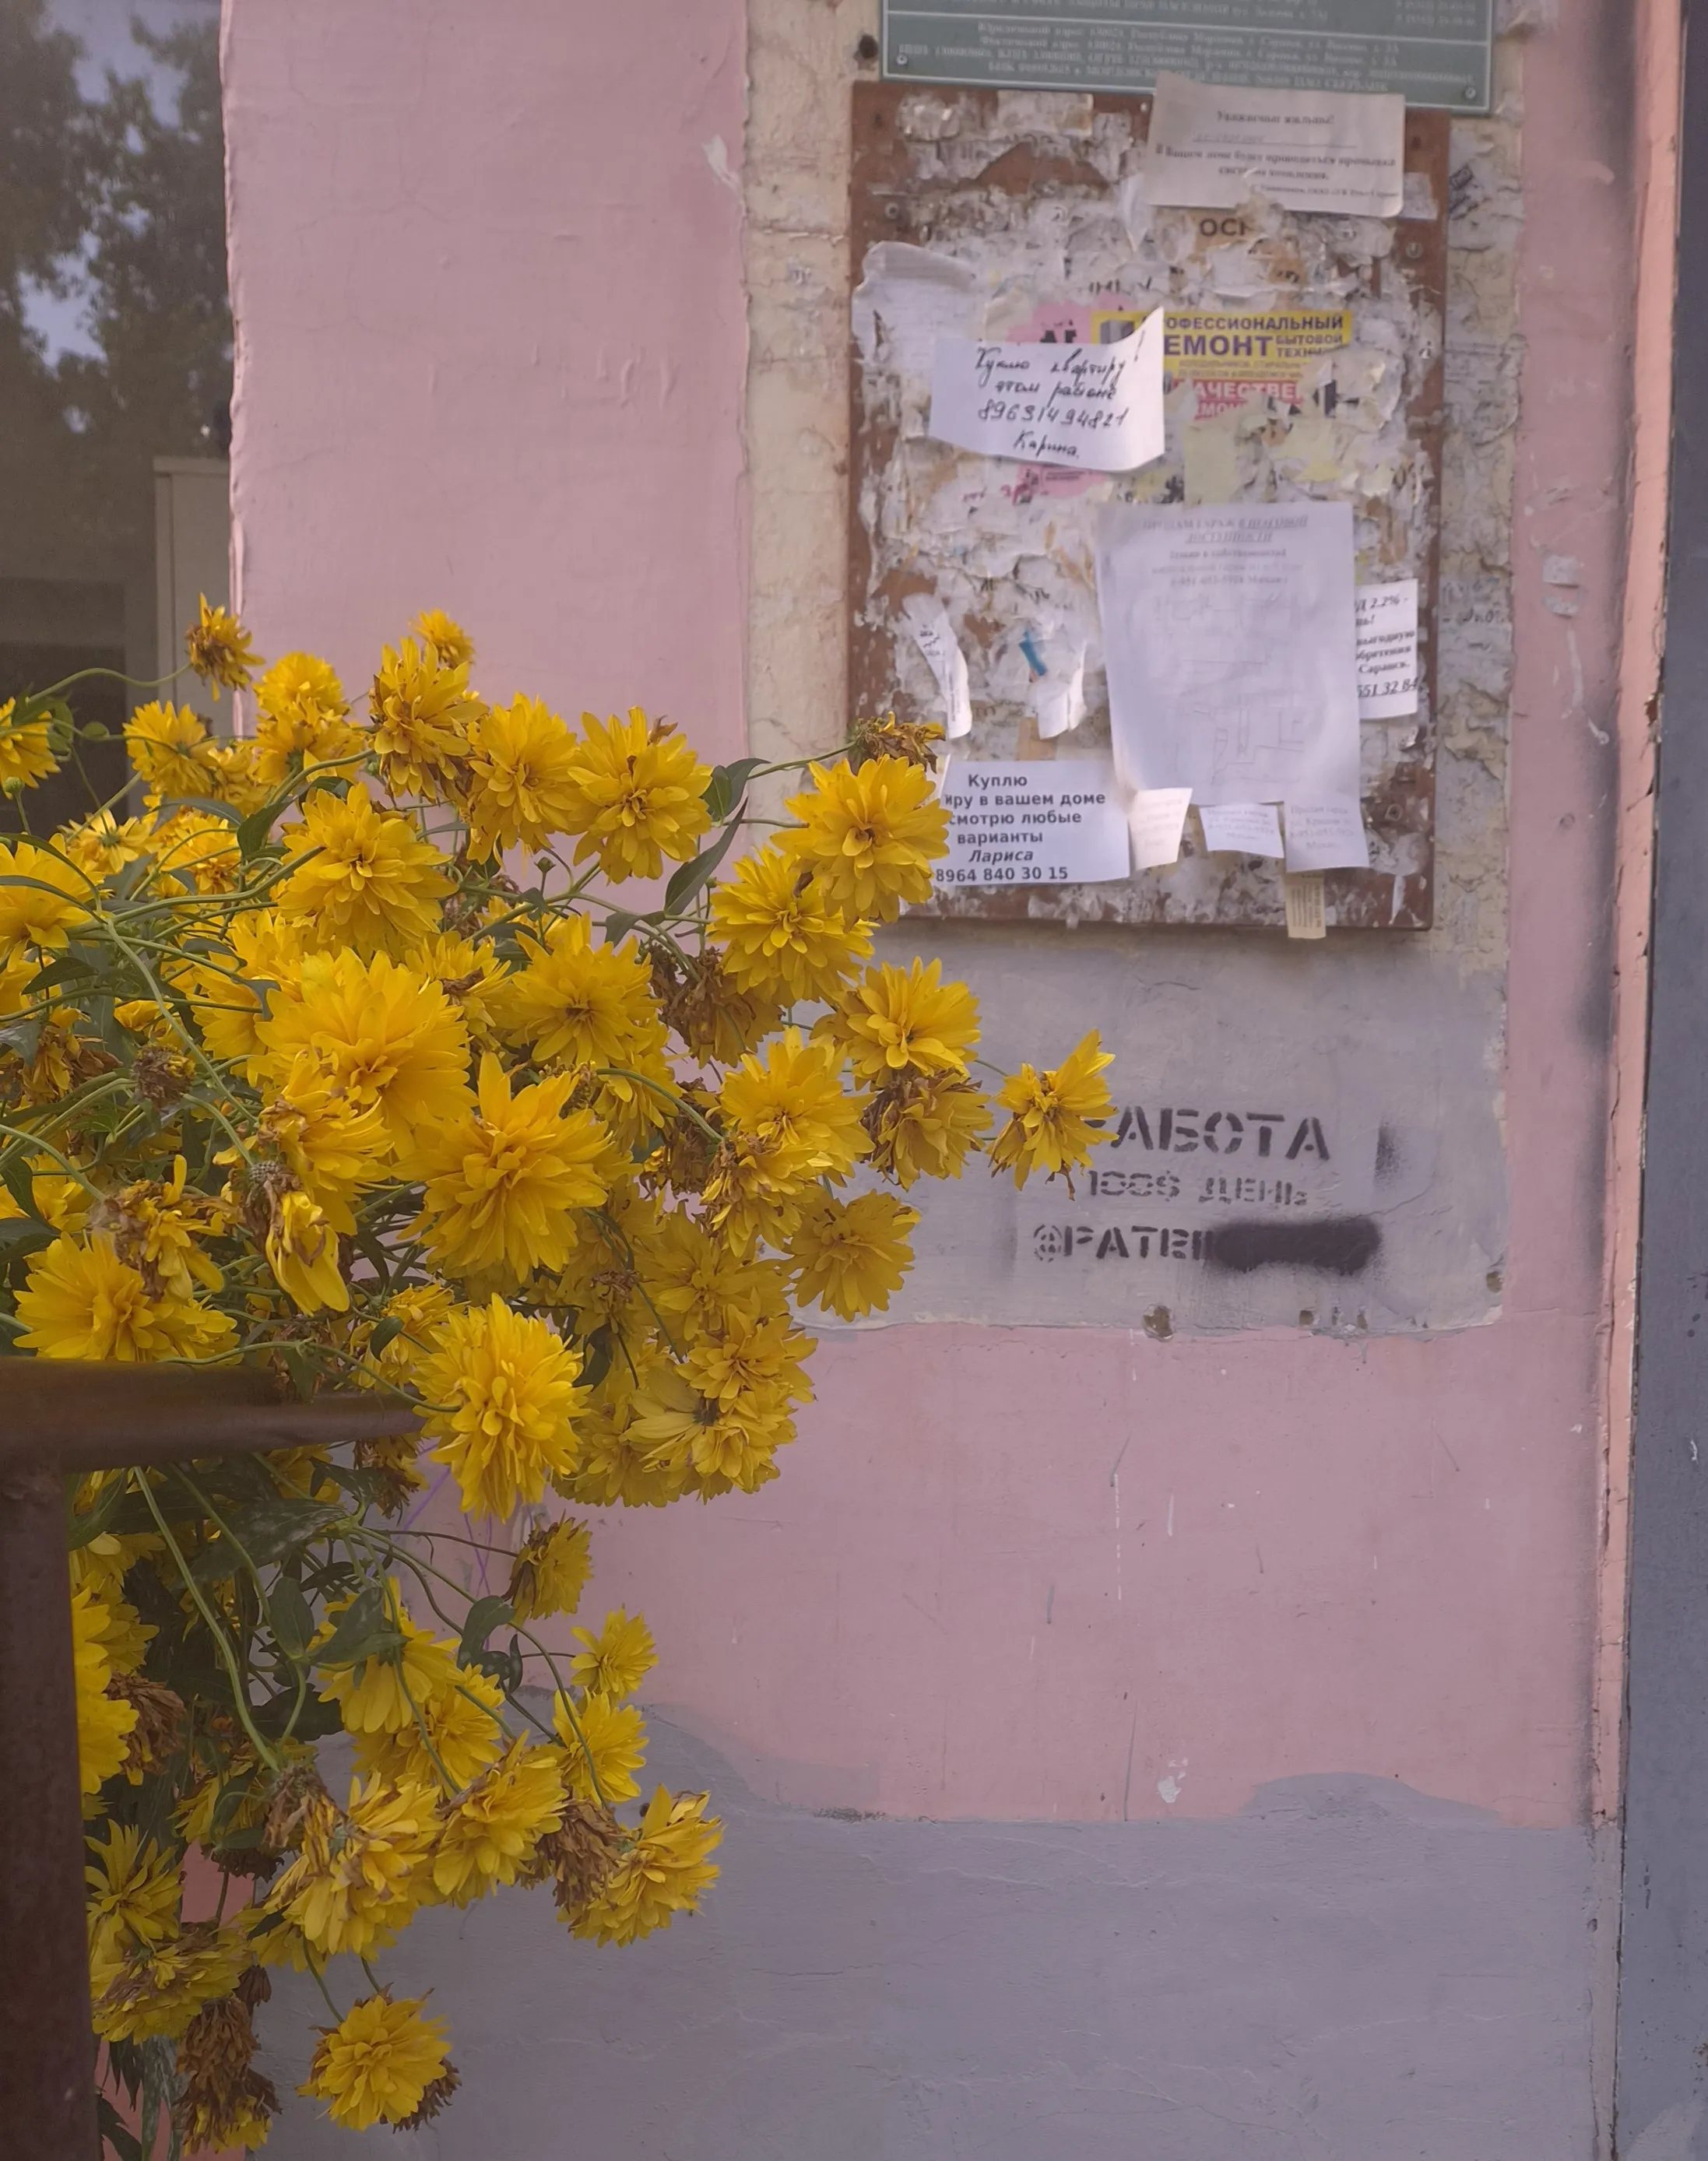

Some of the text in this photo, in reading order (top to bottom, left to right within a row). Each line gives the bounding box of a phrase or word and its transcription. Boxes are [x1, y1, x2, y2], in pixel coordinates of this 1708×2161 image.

[1163, 315, 1344, 331] ОФЕССИОНАЛЬНЫЙ
[1163, 334, 1274, 357] ЕМОНТ
[1191, 381, 1303, 401] АЧЕСТВЕ
[968, 774, 1028, 790] Куплю
[944, 792, 1107, 810] иру в вашем доме
[949, 810, 1083, 828] смотрю любые
[957, 831, 1043, 846] варианты
[968, 849, 1035, 866] Лариса
[935, 866, 1069, 883] 8964 840 30 15
[1085, 1105, 1330, 1161] АБОТА
[1198, 1176, 1309, 1207] ДЕНЬ
